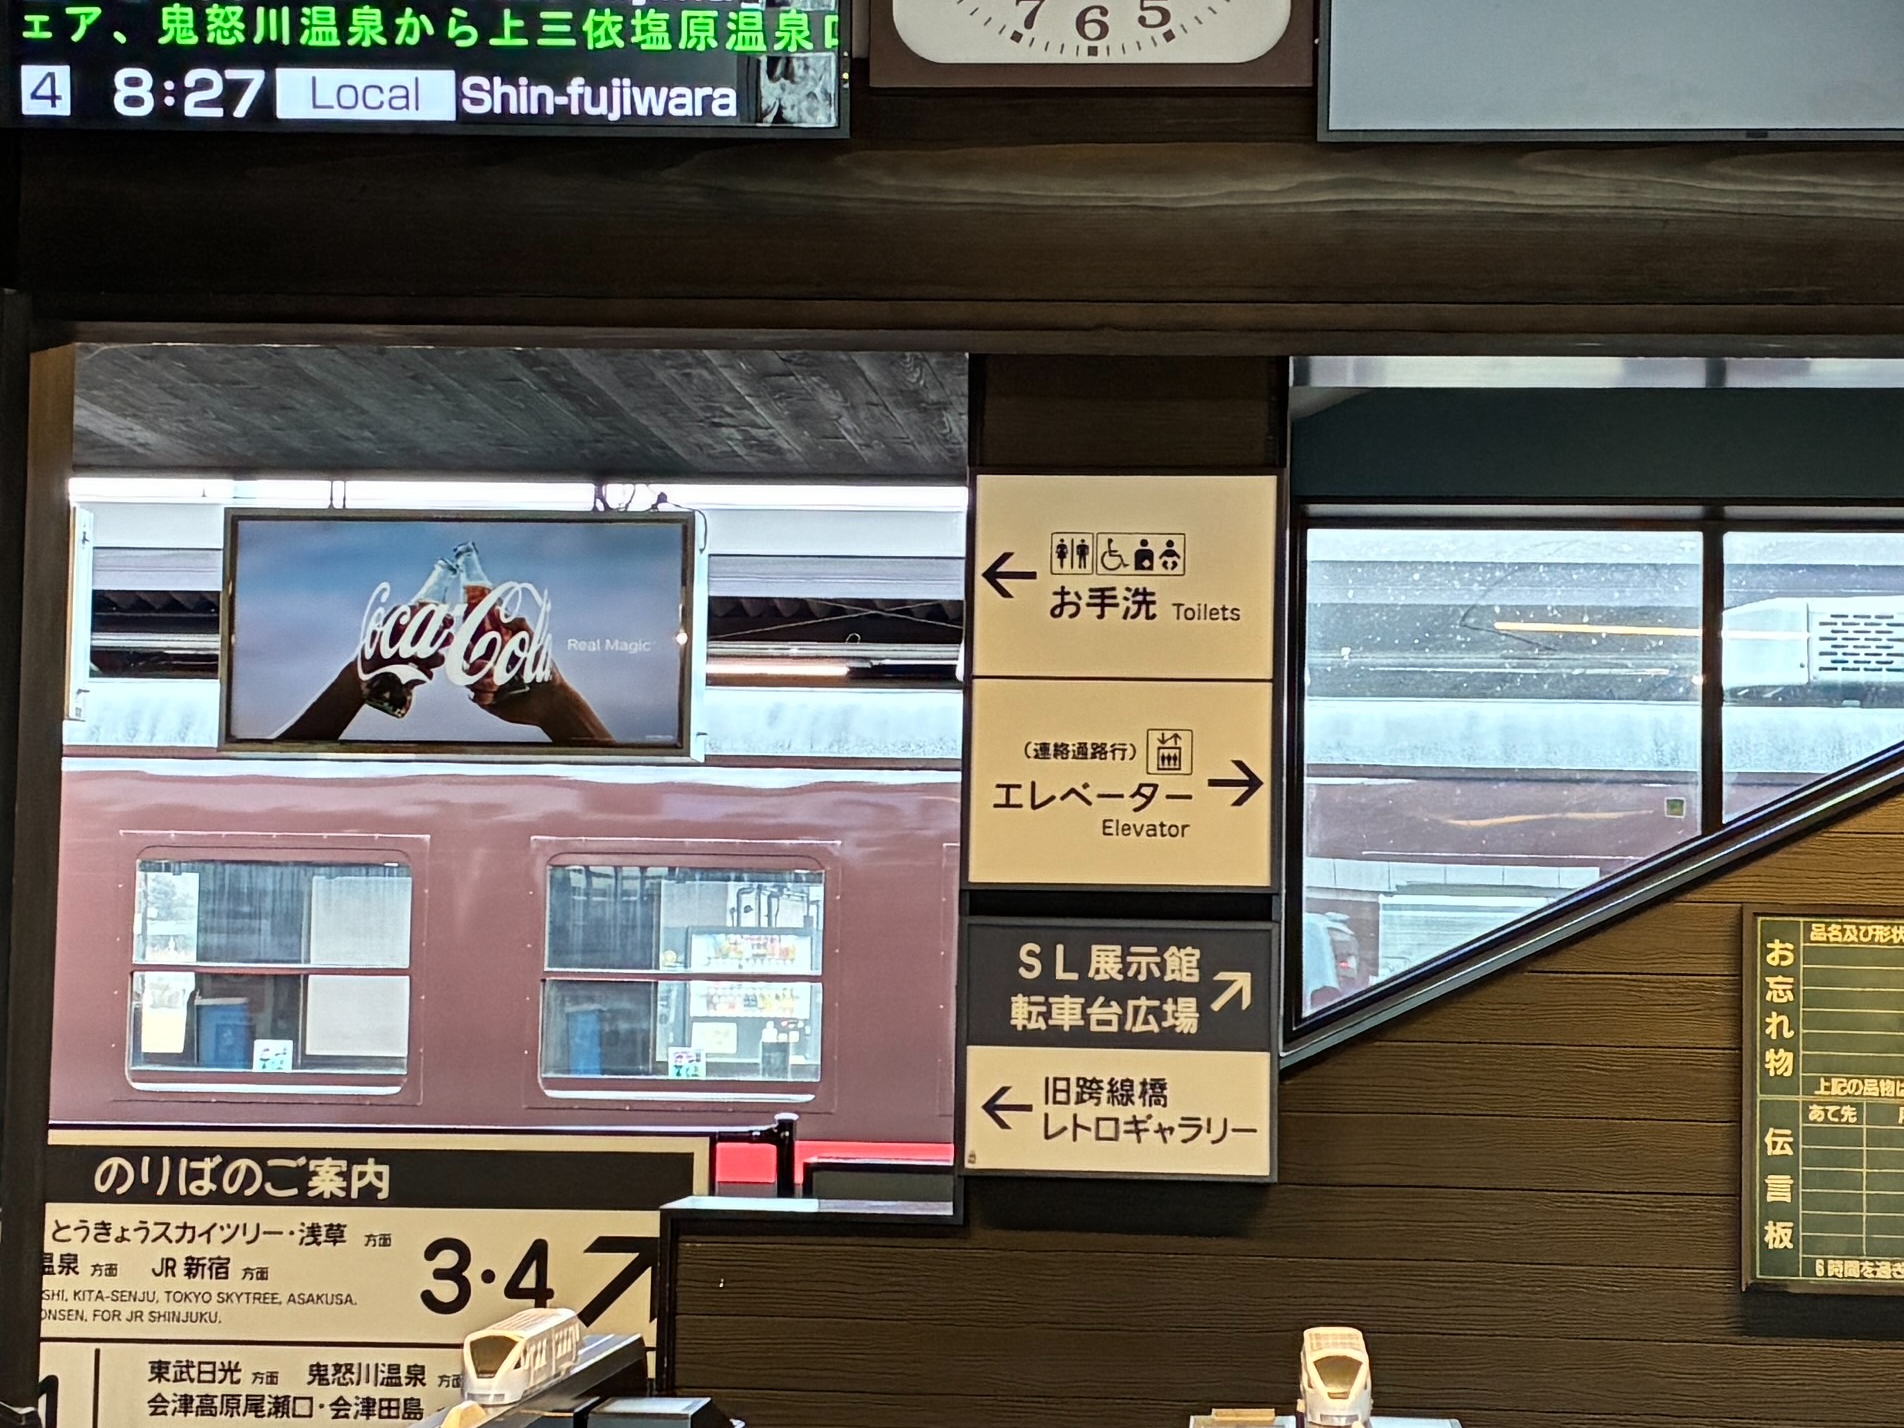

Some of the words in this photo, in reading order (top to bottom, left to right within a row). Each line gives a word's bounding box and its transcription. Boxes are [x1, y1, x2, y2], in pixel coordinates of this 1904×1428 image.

[1075, 4, 1110, 41] 6
[30, 72, 62, 108] 4
[112, 67, 266, 120] 8:27
[309, 76, 422, 113] Local
[460, 77, 738, 121] Shin-fujiwara
[1048, 584, 1158, 621] お手洗
[1171, 602, 1242, 622] Toilets
[567, 638, 601, 653] Real
[605, 638, 652, 654] Magic
[992, 780, 1194, 813] エレベーター
[1101, 818, 1191, 837] Elevator
[1009, 993, 1201, 1034] 転車台広場
[1763, 938, 1795, 1079] お忘れ物
[1043, 1076, 1169, 1109] 旧跨線橋
[1042, 1112, 1258, 1145] レトロギャラリー
[1807, 1103, 1858, 1124] あて先
[93, 1156, 392, 1201] のりばのご案内
[1764, 1126, 1795, 1252] 伝言板
[50, 1219, 348, 1248] とうきょうスカイツリー・浅草
[363, 1233, 393, 1248] 方面
[90, 1263, 118, 1278] 方面
[151, 1257, 177, 1278] JR
[182, 1255, 232, 1281] 新宿
[241, 1267, 270, 1282] 方面
[165, 1290, 213, 1305] TOKYO
[93, 1309, 121, 1323] FOR
[125, 1310, 144, 1323] JR
[147, 1359, 242, 1386] 東武日光
[251, 1371, 279, 1386] 方面
[306, 1361, 428, 1388] 鬼怒川温泉
[146, 1392, 425, 1422] 会津高原尾瀬口・会津田島
